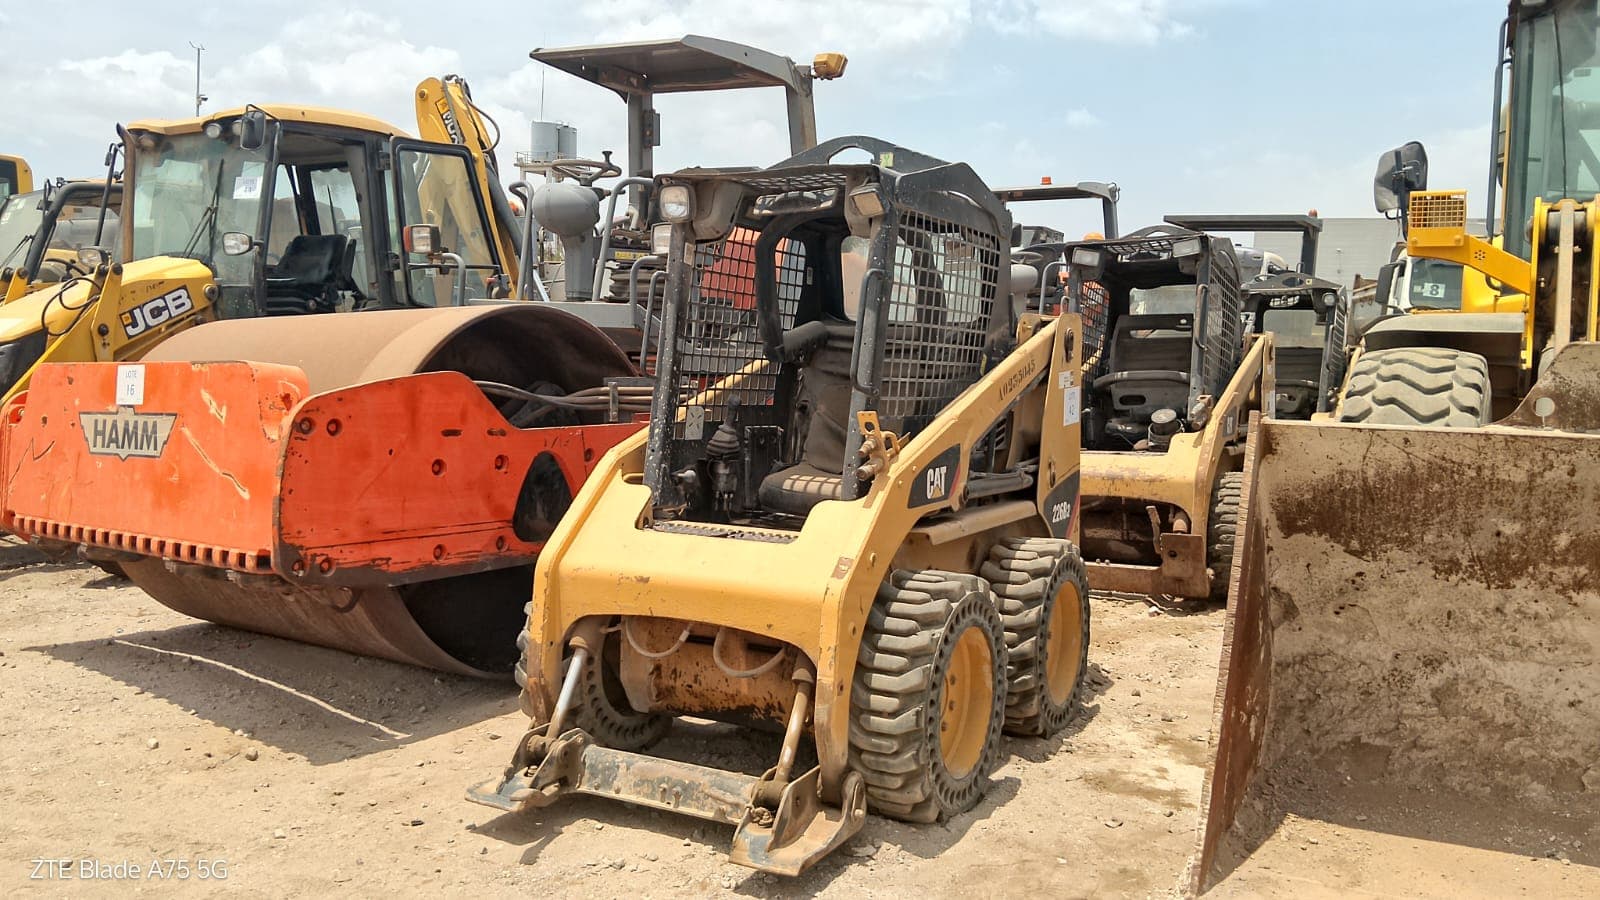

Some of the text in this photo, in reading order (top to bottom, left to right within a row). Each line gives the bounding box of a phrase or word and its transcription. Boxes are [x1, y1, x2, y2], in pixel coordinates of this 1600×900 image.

[125, 288, 192, 336] JCB
[126, 384, 135, 396] 16
[93, 418, 158, 452] HAMM
[926, 465, 947, 500] CAT
